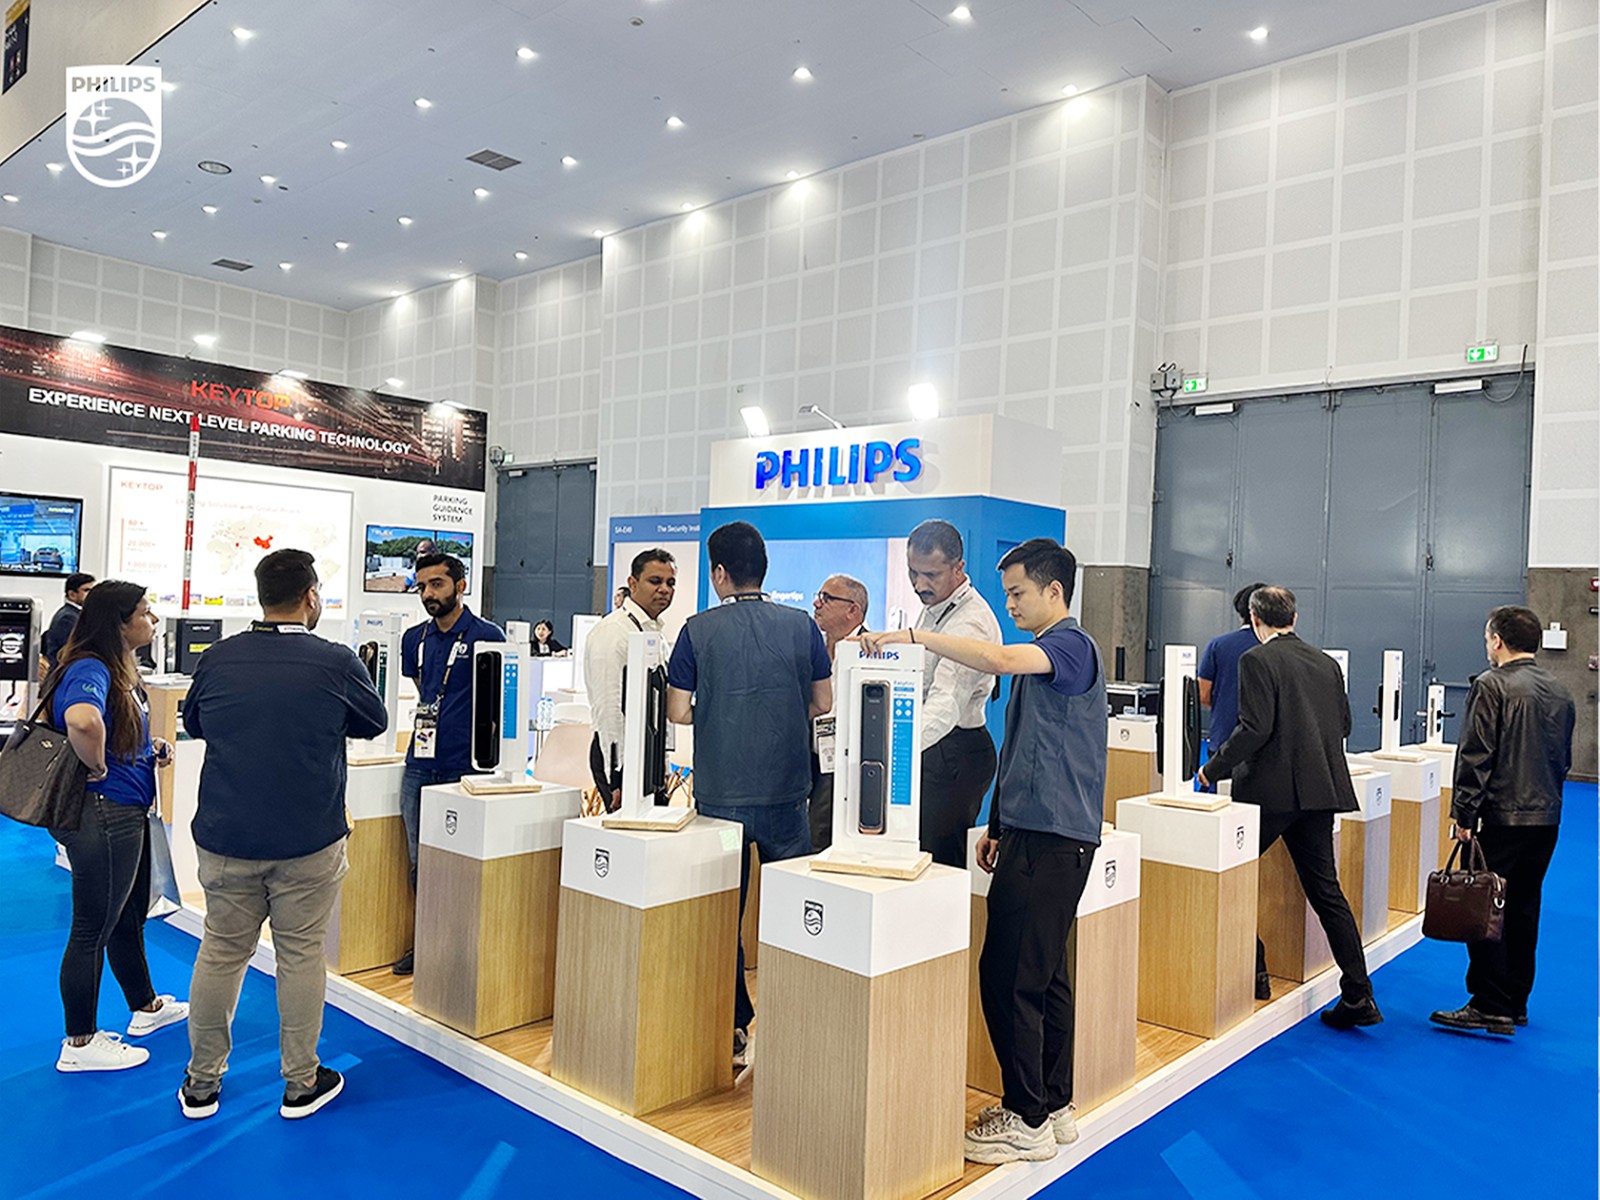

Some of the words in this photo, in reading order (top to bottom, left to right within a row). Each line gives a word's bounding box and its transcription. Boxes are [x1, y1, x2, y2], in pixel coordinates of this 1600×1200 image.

[190, 379, 292, 411] KEYTOP
[28, 387, 146, 418] EXPERIENCE
[149, 405, 194, 424] NEXT
[198, 412, 249, 433] LEVEL
[250, 421, 316, 442] PARKING
[318, 430, 412, 455] TECHNOLOGY
[755, 438, 922, 490] PHILIPS
[120, 480, 164, 491] KEYTOP
[433, 494, 468, 506] PARKING
[432, 504, 473, 516] GUIDANCE
[432, 514, 463, 523] SYSTEM
[656, 524, 667, 533] The
[667, 524, 688, 534] Security
